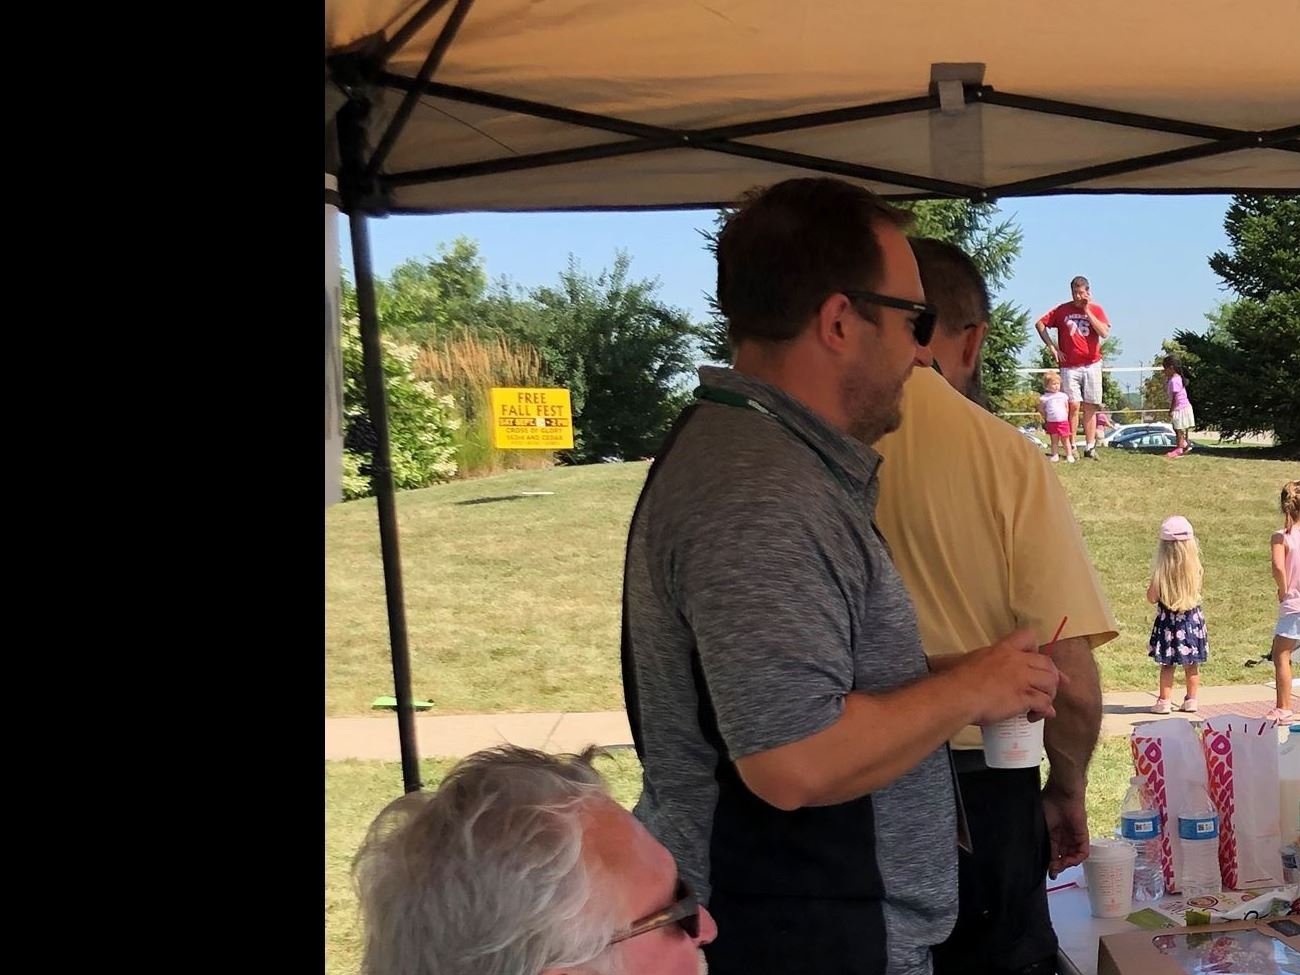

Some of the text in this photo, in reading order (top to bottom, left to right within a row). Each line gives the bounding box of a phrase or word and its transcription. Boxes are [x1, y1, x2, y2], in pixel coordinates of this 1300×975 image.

[1067, 320, 1090, 336] 76
[518, 393, 546, 404] FREE
[501, 405, 563, 416] FALL FEST
